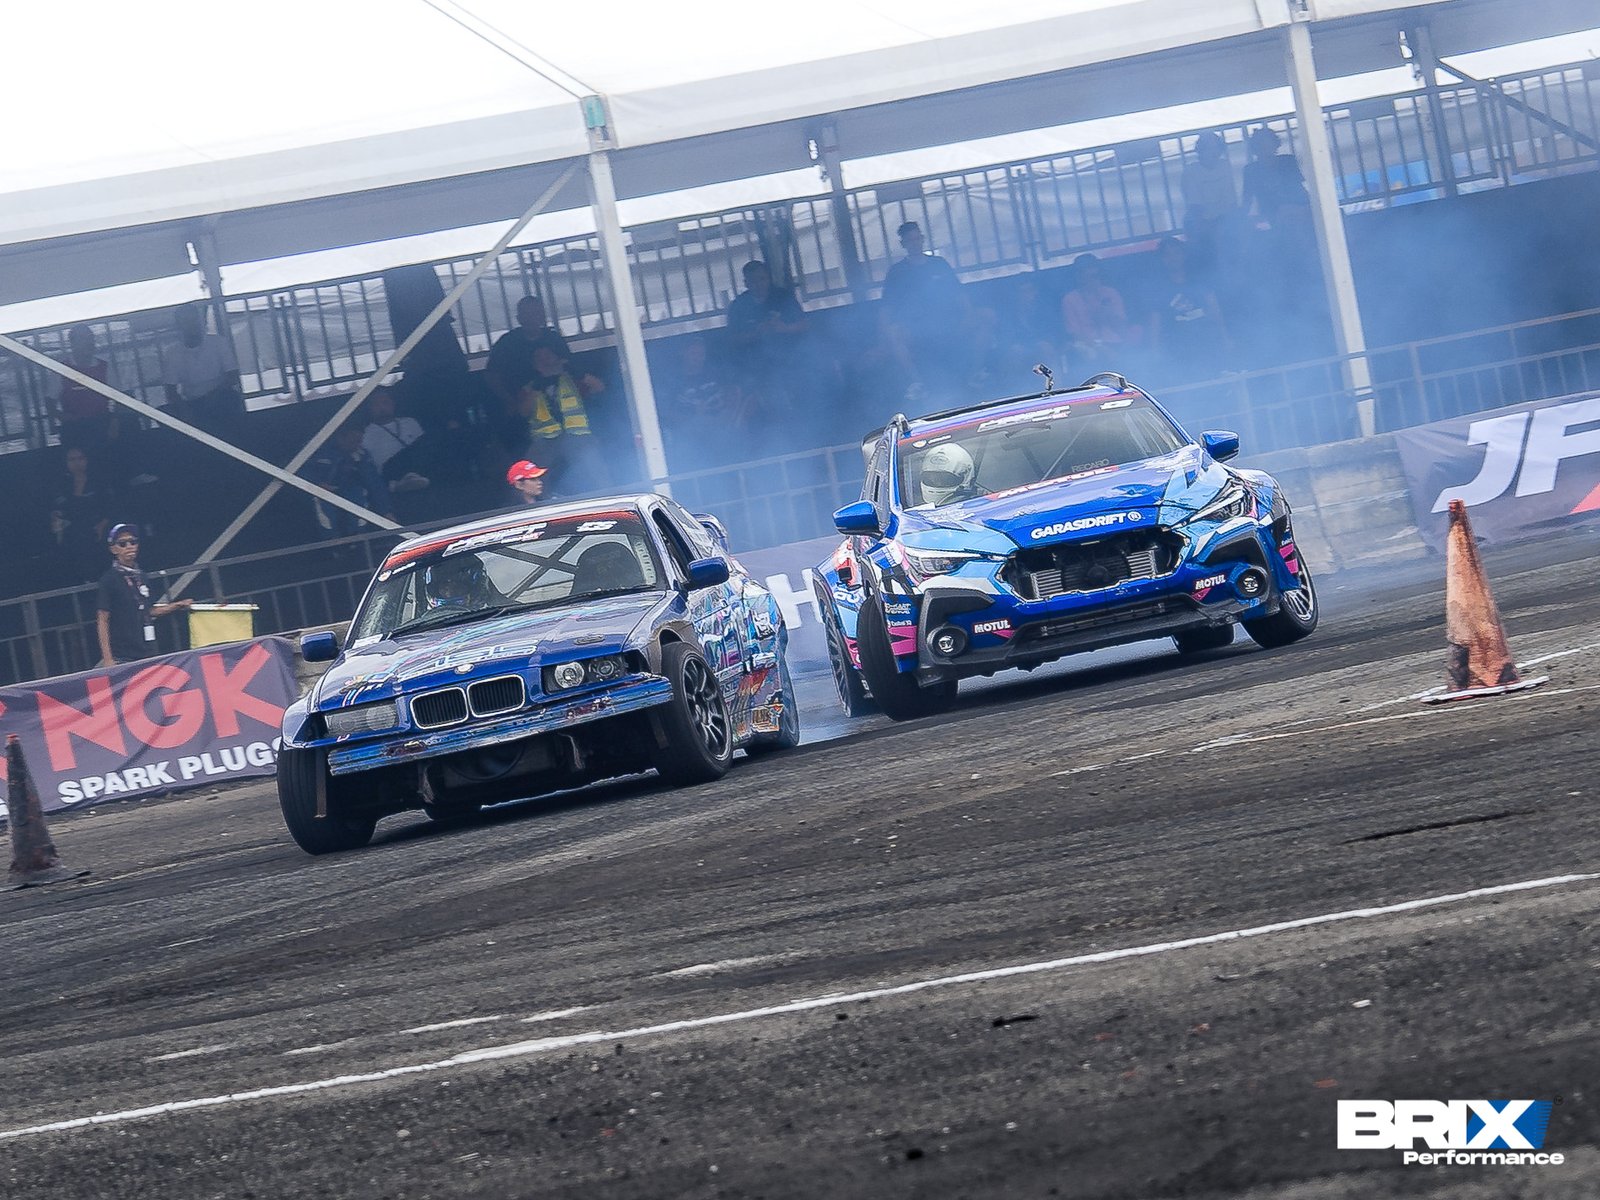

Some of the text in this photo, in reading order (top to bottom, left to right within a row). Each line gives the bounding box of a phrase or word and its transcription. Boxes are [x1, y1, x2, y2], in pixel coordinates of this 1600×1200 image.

[1071, 458, 1109, 473] RECARO
[1030, 512, 1127, 539] GARASIDRIFT
[1195, 574, 1227, 590] MOTUL
[974, 619, 1011, 634] MOTUL
[34, 643, 285, 772] NGK
[57, 761, 176, 804] SPARK
